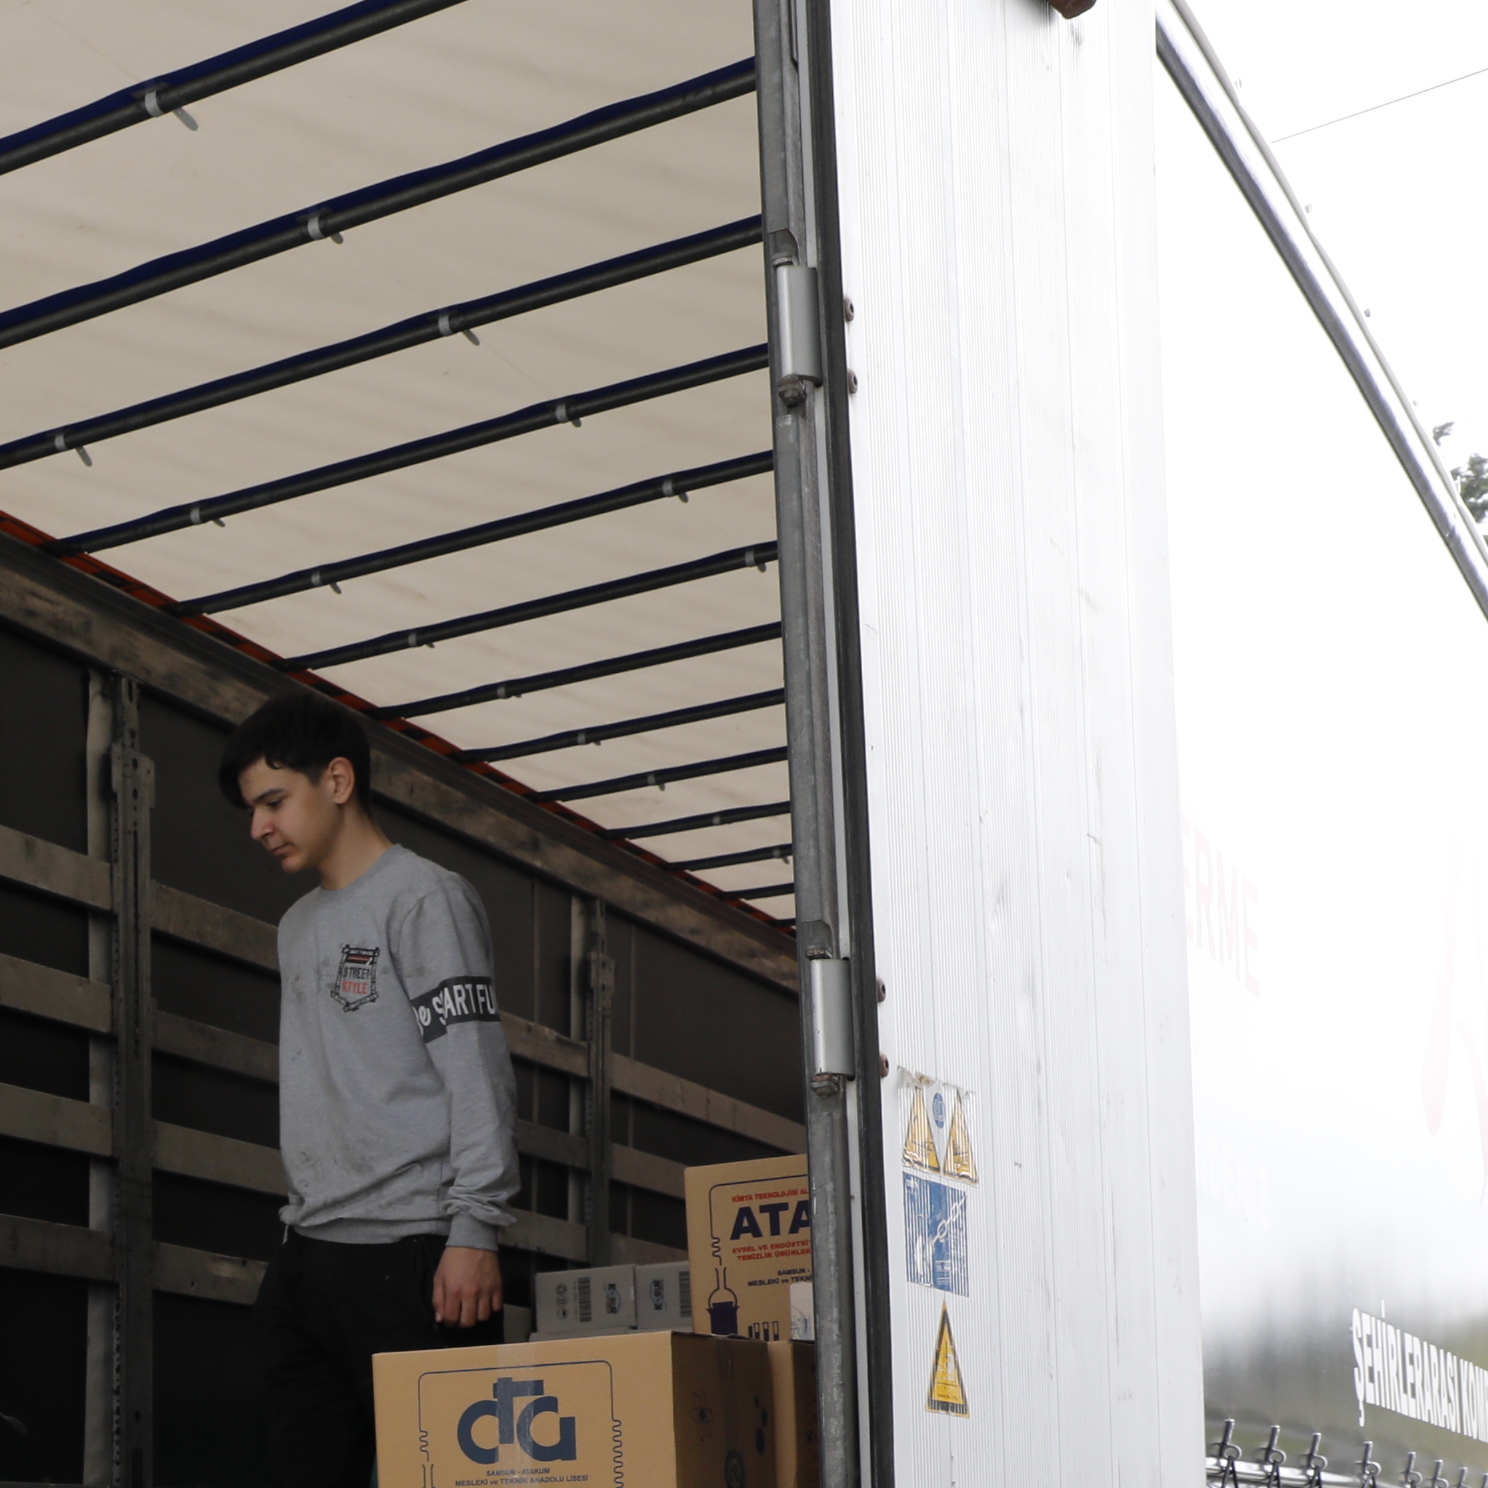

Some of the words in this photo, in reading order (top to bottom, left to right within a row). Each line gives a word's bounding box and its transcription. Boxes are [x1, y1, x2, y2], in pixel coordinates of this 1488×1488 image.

[342, 966, 370, 980] STREET
[341, 981, 369, 994] STYLE
[730, 1199, 812, 1241] ATA
[775, 1248, 812, 1258] ÜRÜNLER
[1352, 1299, 1462, 1434] ŞEHİRLERARASI
[521, 1467, 550, 1475] ATAKUM
[530, 1475, 564, 1484] ANADOLU
